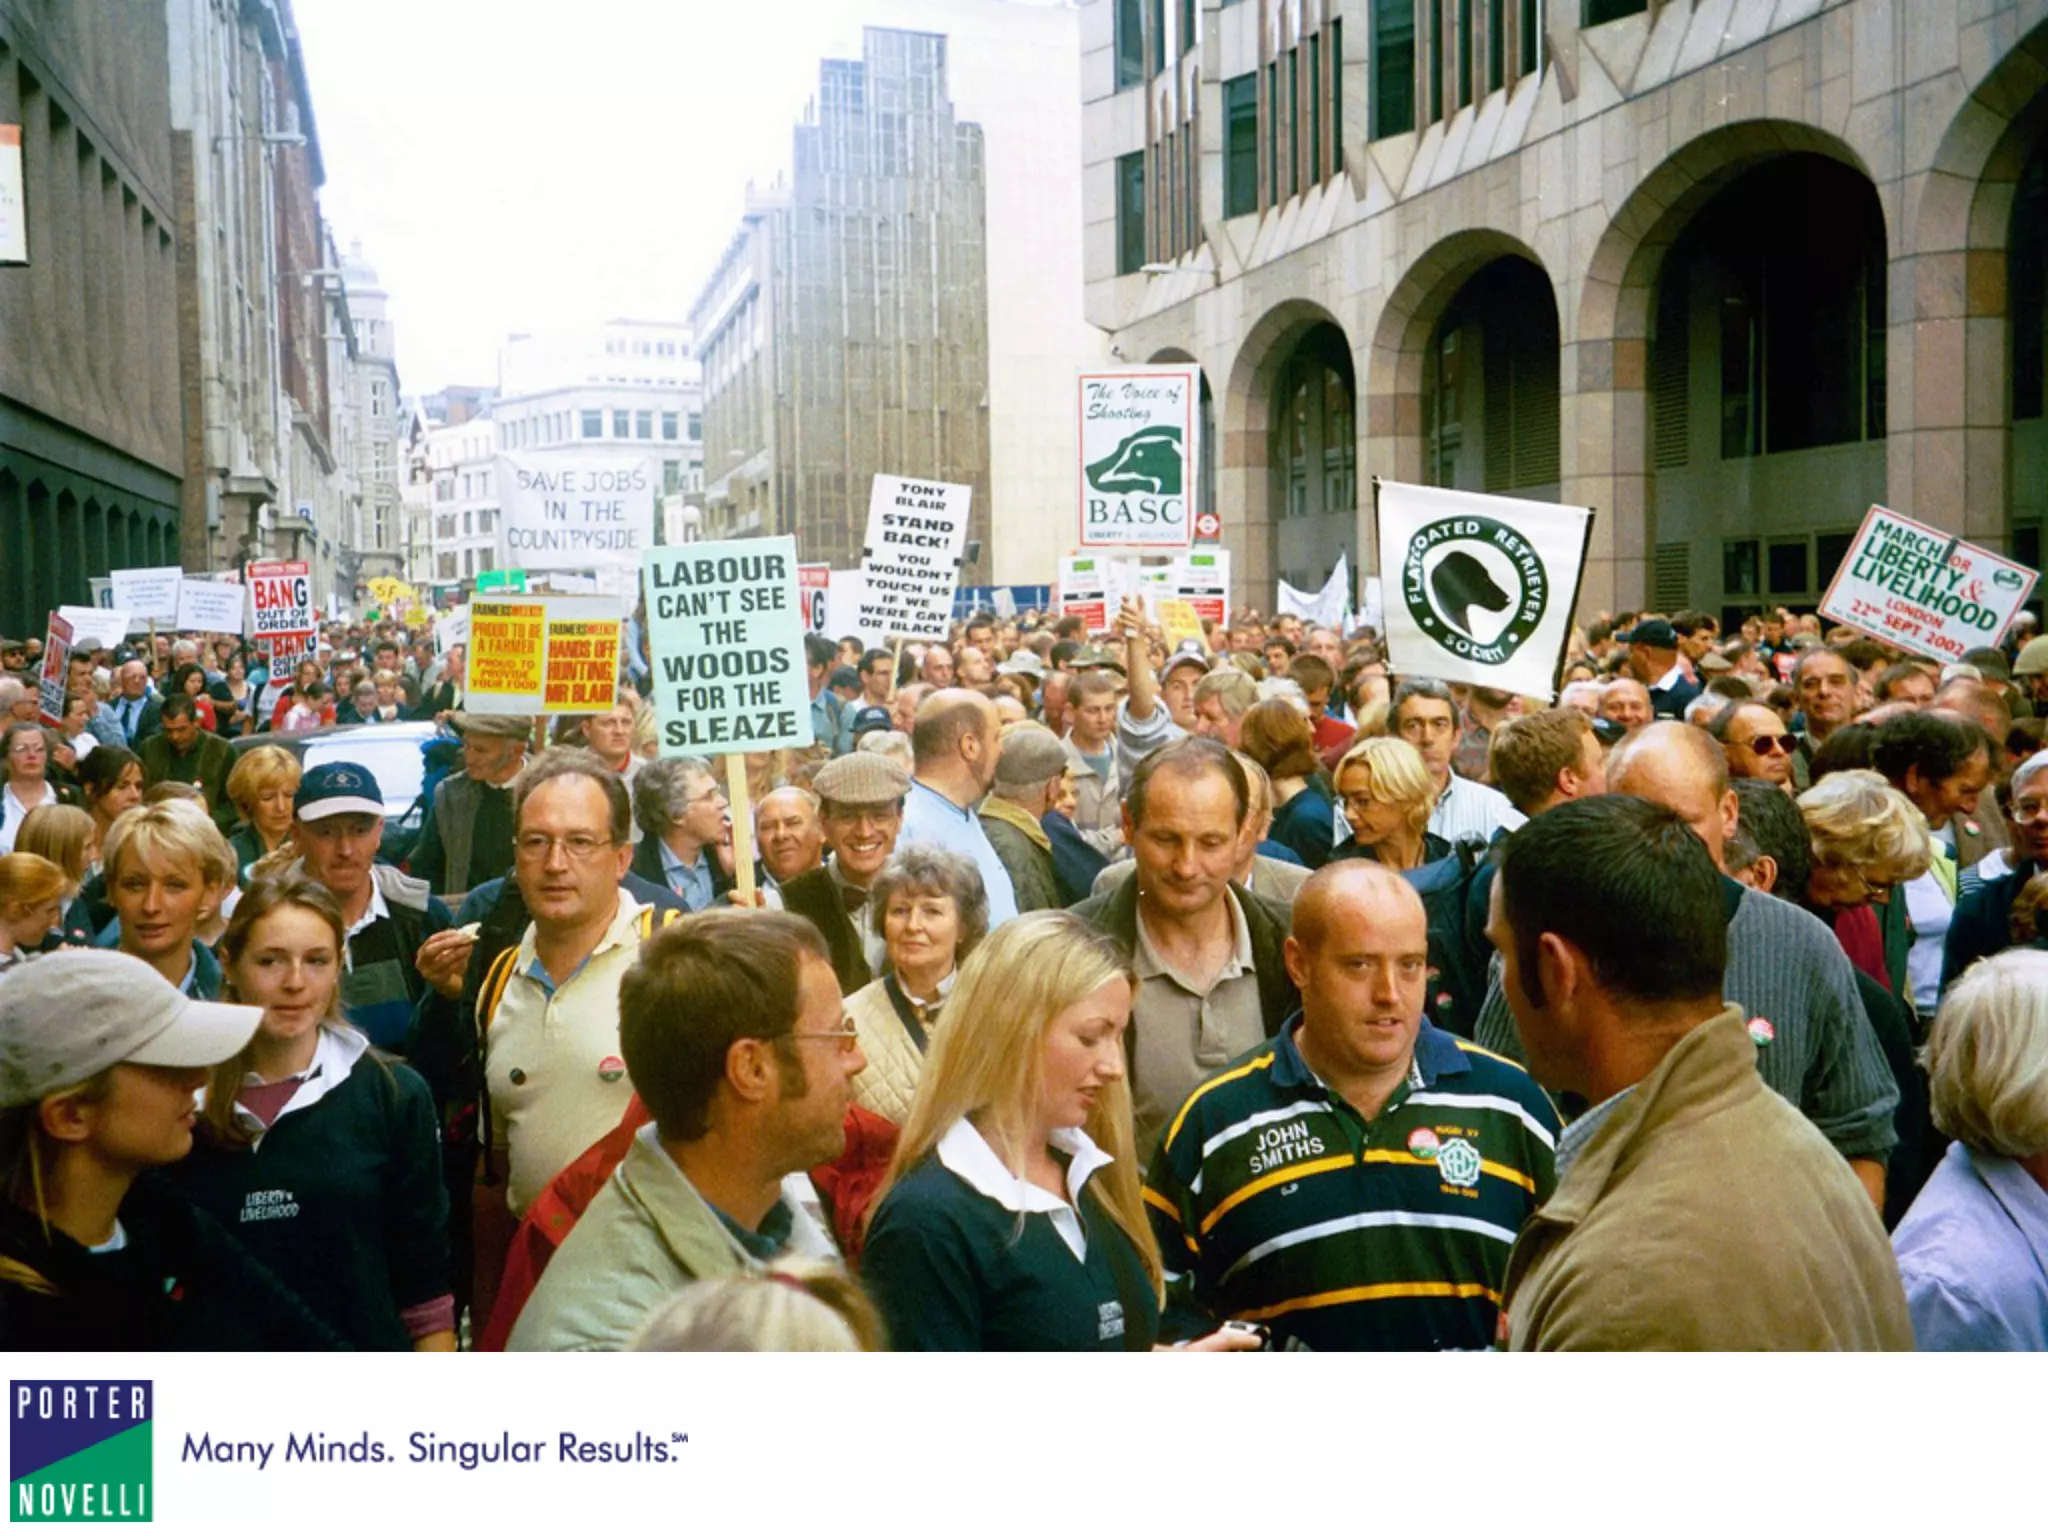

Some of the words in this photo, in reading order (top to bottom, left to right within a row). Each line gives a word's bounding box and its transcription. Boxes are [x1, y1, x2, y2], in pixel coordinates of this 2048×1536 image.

[1087, 383, 1113, 400] The
[1120, 383, 1160, 400] Voice
[1165, 384, 1182, 404] of
[1086, 403, 1152, 424] Shooting
[517, 469, 576, 493] SAVE
[583, 468, 647, 493] JOBS
[900, 483, 946, 497] TONY
[544, 500, 566, 521] IN
[580, 500, 626, 521] THE
[895, 496, 947, 511] BLAIR
[1088, 498, 1182, 524] BASC
[882, 513, 955, 533] STAND
[508, 527, 640, 550] COUNTRYSIDE
[883, 531, 950, 549] BACK!
[1873, 519, 1944, 561] MARCH
[1949, 553, 1973, 573] OR
[898, 553, 931, 566] YOU
[1863, 535, 1966, 591] LIBERTY
[1960, 578, 1985, 603] &
[652, 554, 786, 589] LABOUR
[1494, 527, 1543, 623] RETRIEVER
[254, 578, 308, 609] BANG
[865, 578, 923, 594] TOUCH
[929, 585, 951, 597] US
[1851, 556, 1999, 631] LIVELIHOOD
[657, 590, 732, 620] CAN'T
[739, 586, 786, 613] SEE
[800, 590, 825, 631] NG
[882, 594, 898, 604] IF
[905, 597, 930, 608] WE
[257, 609, 286, 619] OUT
[291, 608, 309, 618] OF
[860, 604, 909, 619] WERE
[916, 611, 948, 622] GAY
[1885, 597, 1945, 629] LONDON
[257, 619, 309, 630] ORDER
[699, 619, 747, 646] THE
[859, 617, 883, 629] OR
[890, 621, 944, 635] BLACK
[1883, 612, 1923, 637] SEPT
[1925, 630, 1966, 658] 2002
[548, 640, 591, 658] HANDS
[594, 640, 617, 658] OFF
[547, 660, 614, 681] HUNTING
[661, 647, 790, 683] WOODS
[545, 683, 569, 702] MR
[571, 683, 614, 702] BLAIR
[677, 685, 726, 713] FOR
[733, 681, 782, 707] THE
[665, 710, 798, 748] SLEAZE
[1255, 1119, 1309, 1151] JOHN
[1249, 1136, 1325, 1174] SMITHS
[245, 1189, 285, 1207] LIBERTY
[240, 1202, 301, 1223] LIVELIHOOD
